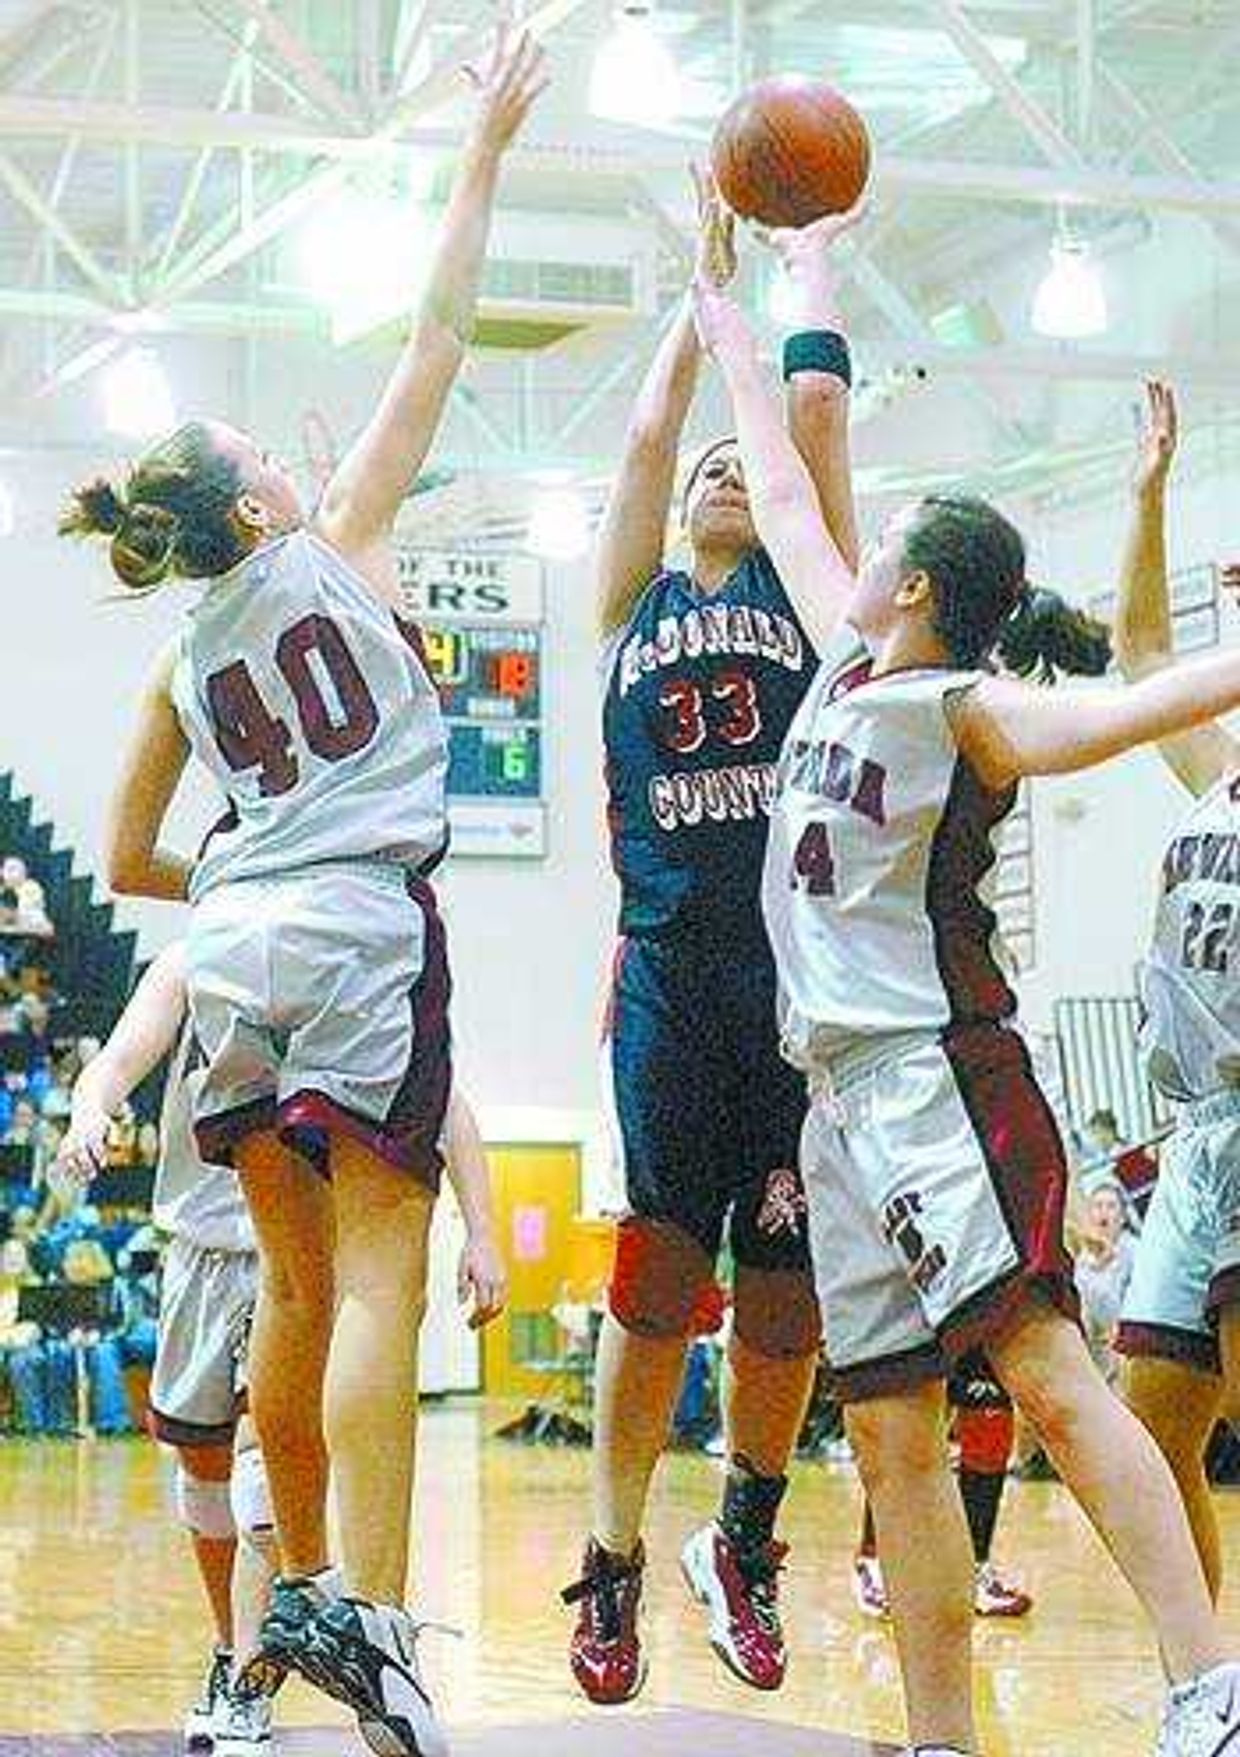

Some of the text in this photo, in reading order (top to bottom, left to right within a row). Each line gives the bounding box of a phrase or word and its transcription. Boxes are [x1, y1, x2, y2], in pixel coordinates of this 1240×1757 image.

[447, 560, 498, 577] THE
[206, 613, 381, 798] 40
[660, 669, 762, 753] 33
[1183, 902, 1231, 973] 22
